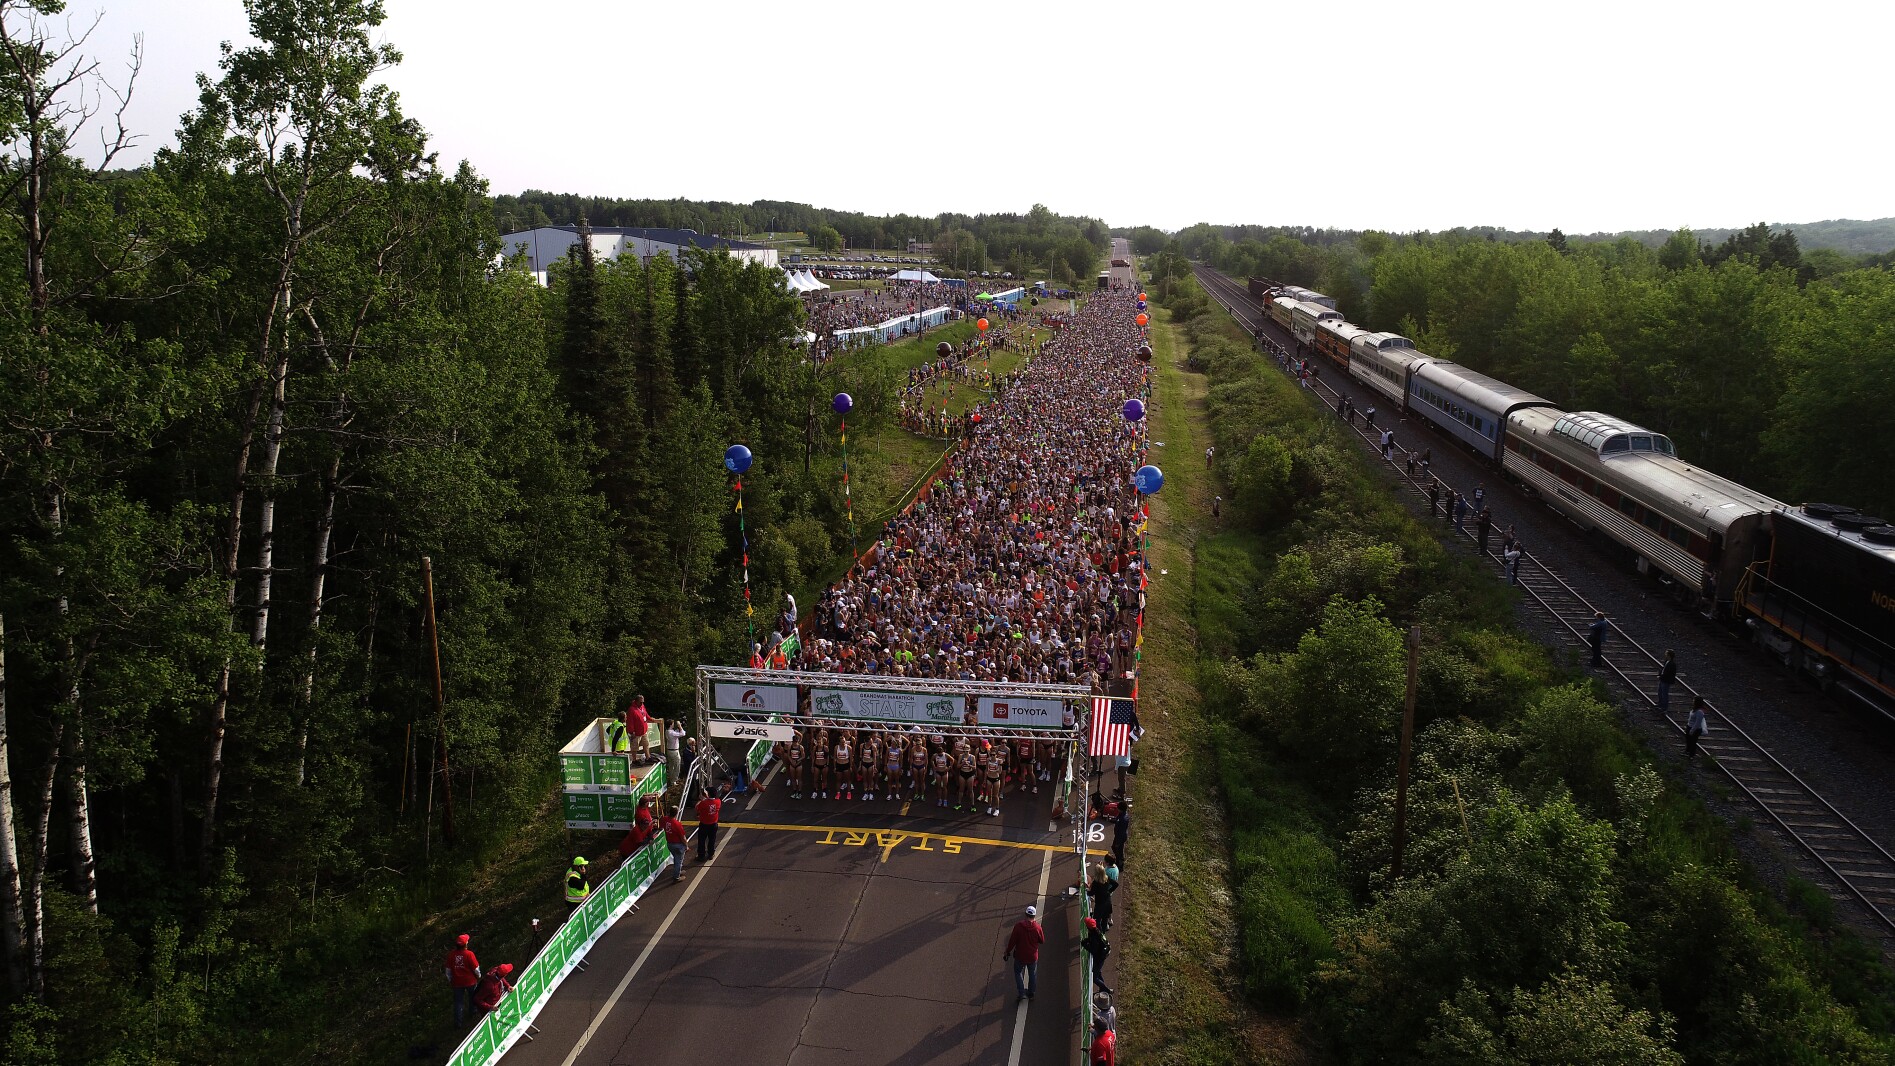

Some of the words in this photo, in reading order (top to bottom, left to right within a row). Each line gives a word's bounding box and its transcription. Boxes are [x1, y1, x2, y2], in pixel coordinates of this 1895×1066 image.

[859, 699, 916, 719] START
[1012, 707, 1048, 716] TOYOTA
[744, 726, 769, 738] asics
[815, 831, 962, 854] START
